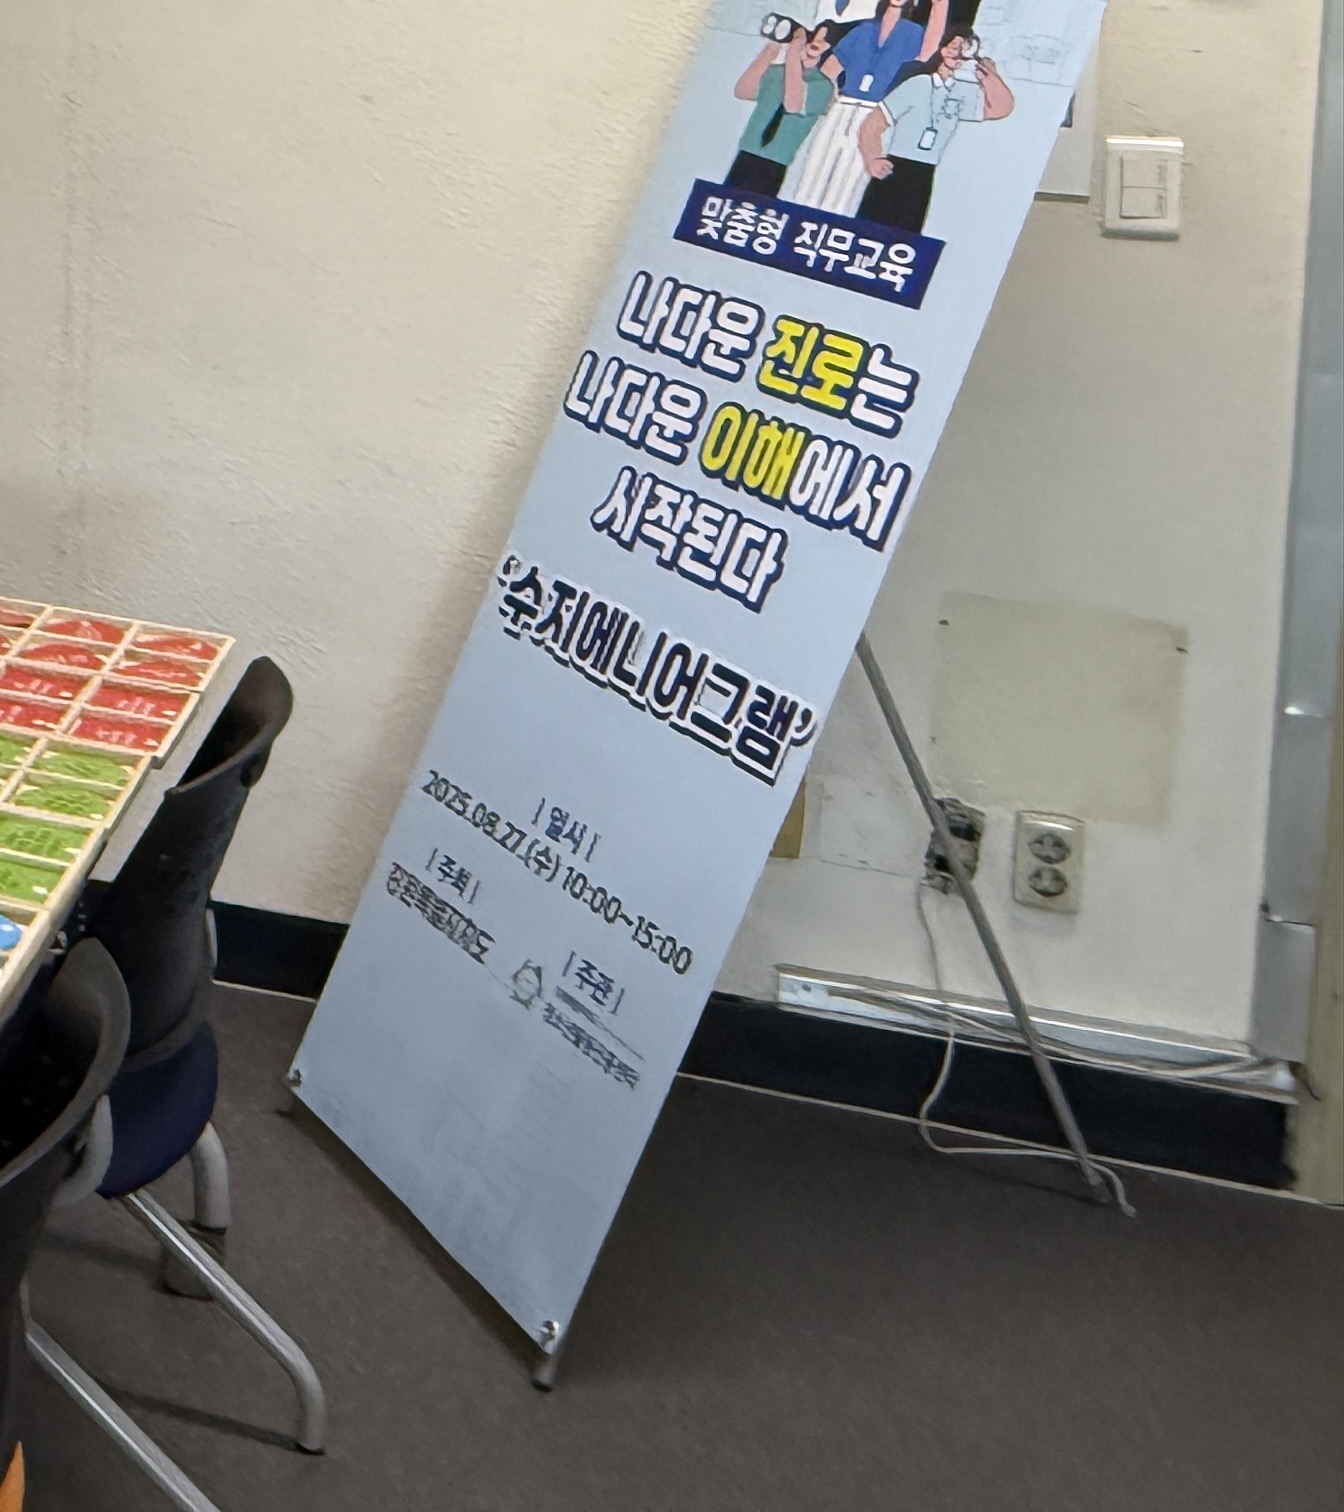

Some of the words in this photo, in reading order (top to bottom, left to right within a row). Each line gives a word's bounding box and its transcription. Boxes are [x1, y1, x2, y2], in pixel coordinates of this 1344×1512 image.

[697, 196, 790, 255] 맞춤형
[792, 220, 917, 293] 직무교육
[617, 270, 766, 383] 나다운
[755, 314, 920, 439] 진로는
[563, 350, 707, 465] 나다운
[699, 402, 912, 552] 이해에서
[590, 466, 788, 614] 시작된다
